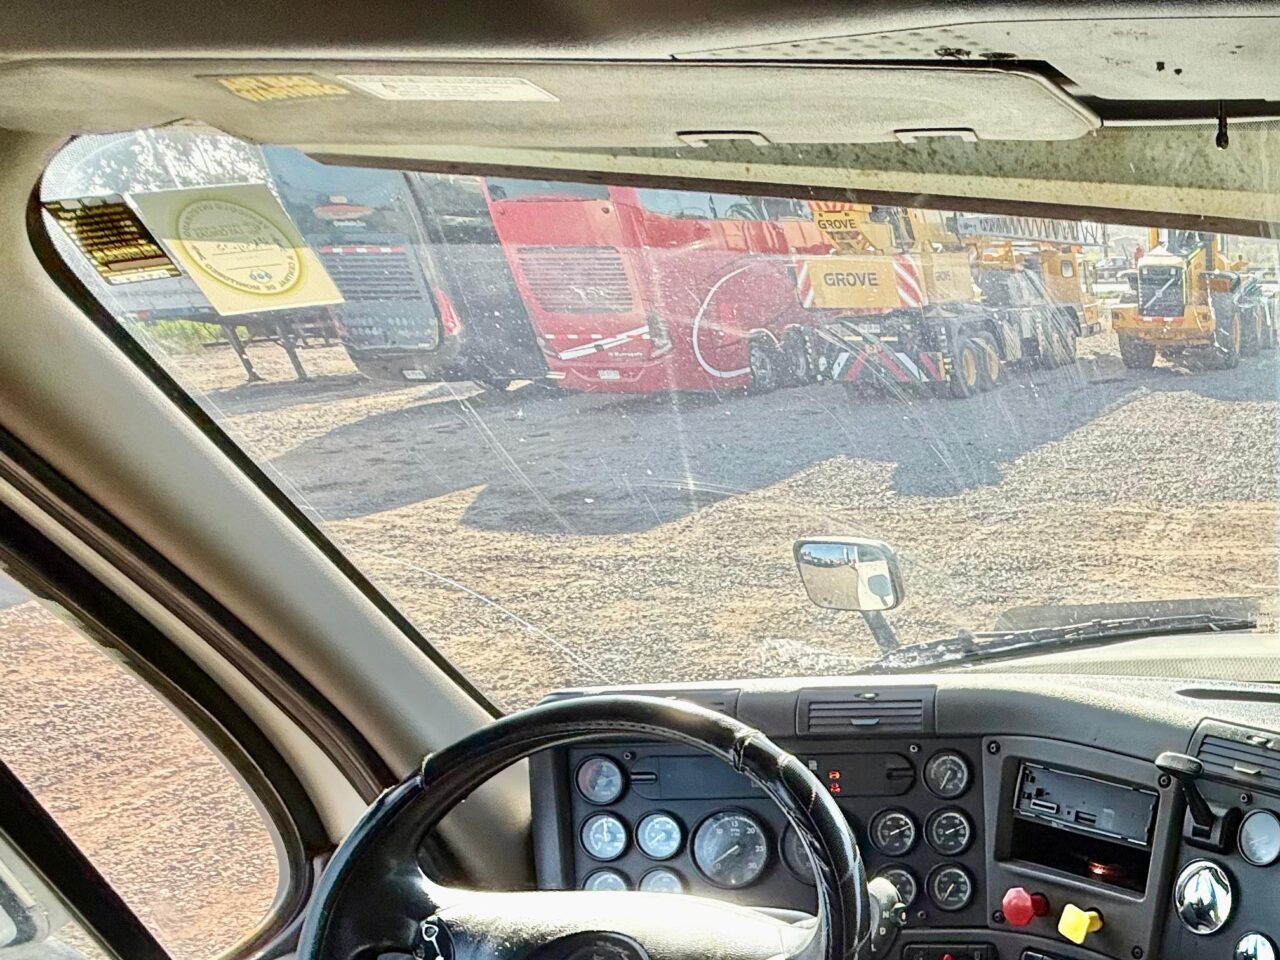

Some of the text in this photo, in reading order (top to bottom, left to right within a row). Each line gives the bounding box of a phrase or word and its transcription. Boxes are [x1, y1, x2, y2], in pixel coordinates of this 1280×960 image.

[817, 218, 858, 230] GROVE
[823, 272, 880, 287] GROVE
[879, 927, 887, 935] D
[871, 944, 877, 952] L
